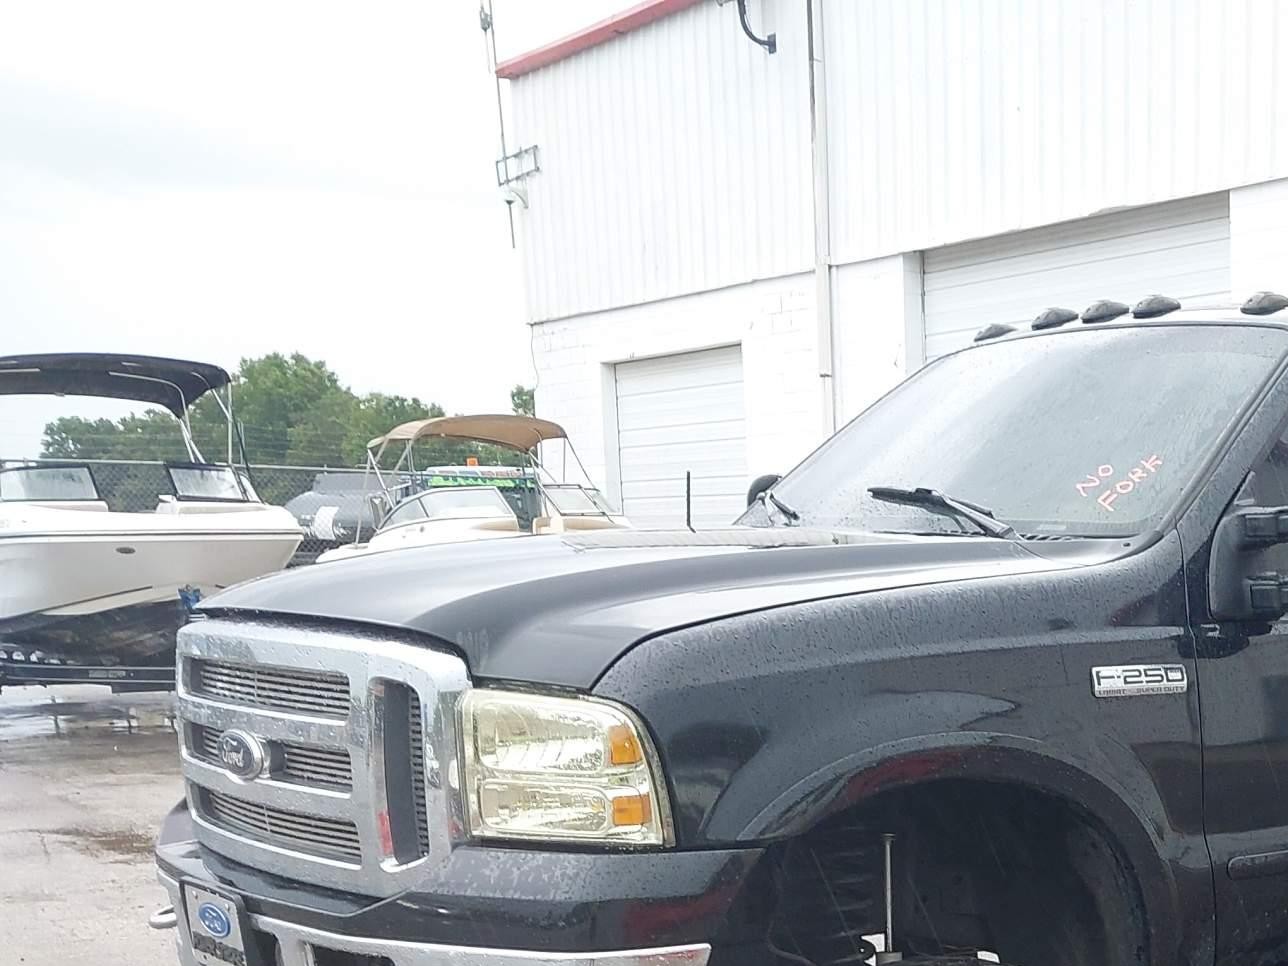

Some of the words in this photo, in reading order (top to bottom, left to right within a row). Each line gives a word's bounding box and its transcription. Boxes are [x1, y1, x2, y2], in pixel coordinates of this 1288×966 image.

[1076, 464, 1113, 497] NO
[1097, 454, 1163, 512] FORK
[1095, 667, 1185, 686] F-250
[222, 736, 244, 768] Ford
